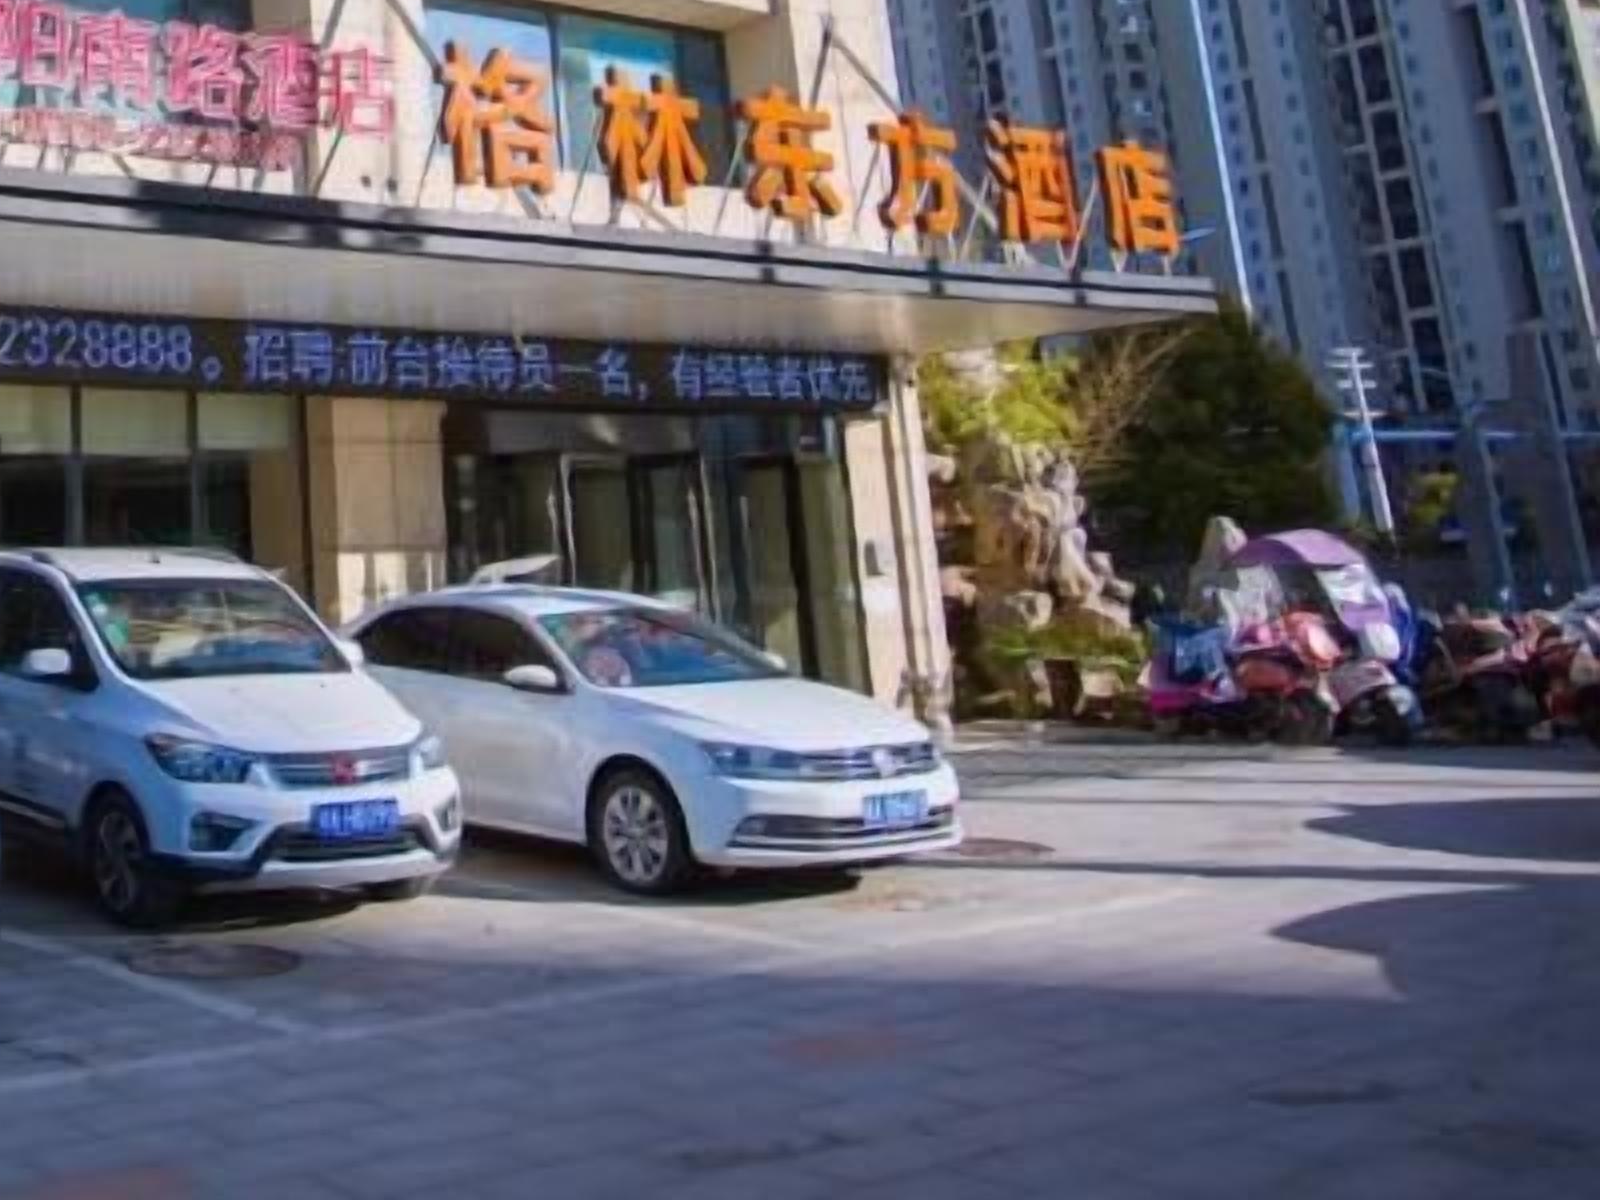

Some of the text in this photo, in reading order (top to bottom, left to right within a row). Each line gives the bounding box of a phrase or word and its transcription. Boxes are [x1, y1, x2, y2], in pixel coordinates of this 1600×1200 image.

[439, 41, 1181, 256] 格林东方酒店
